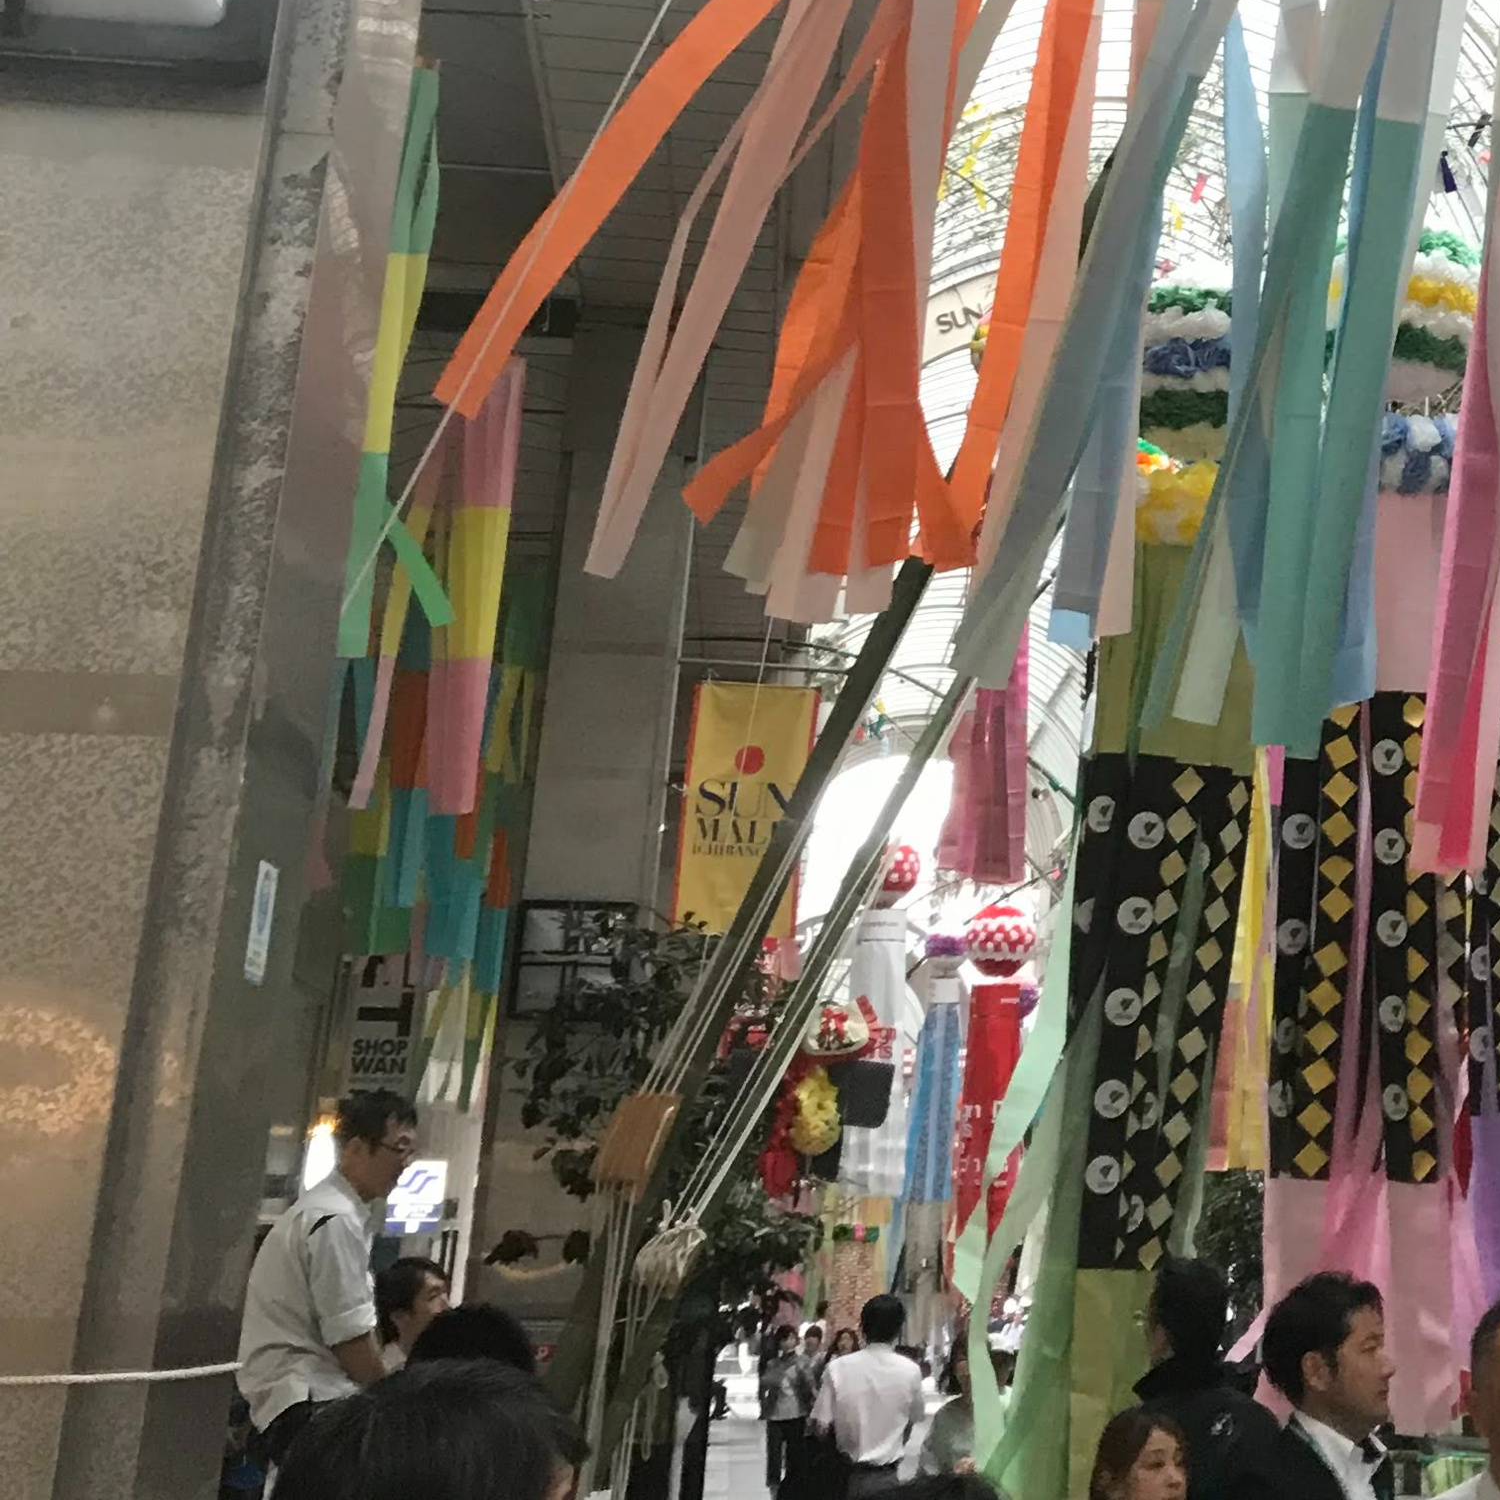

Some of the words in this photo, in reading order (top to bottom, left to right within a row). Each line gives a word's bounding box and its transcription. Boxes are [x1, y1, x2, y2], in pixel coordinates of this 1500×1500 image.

[697, 817, 778, 843] MAL
[353, 1039, 408, 1055] SHOP
[351, 1057, 406, 1074] WAN
